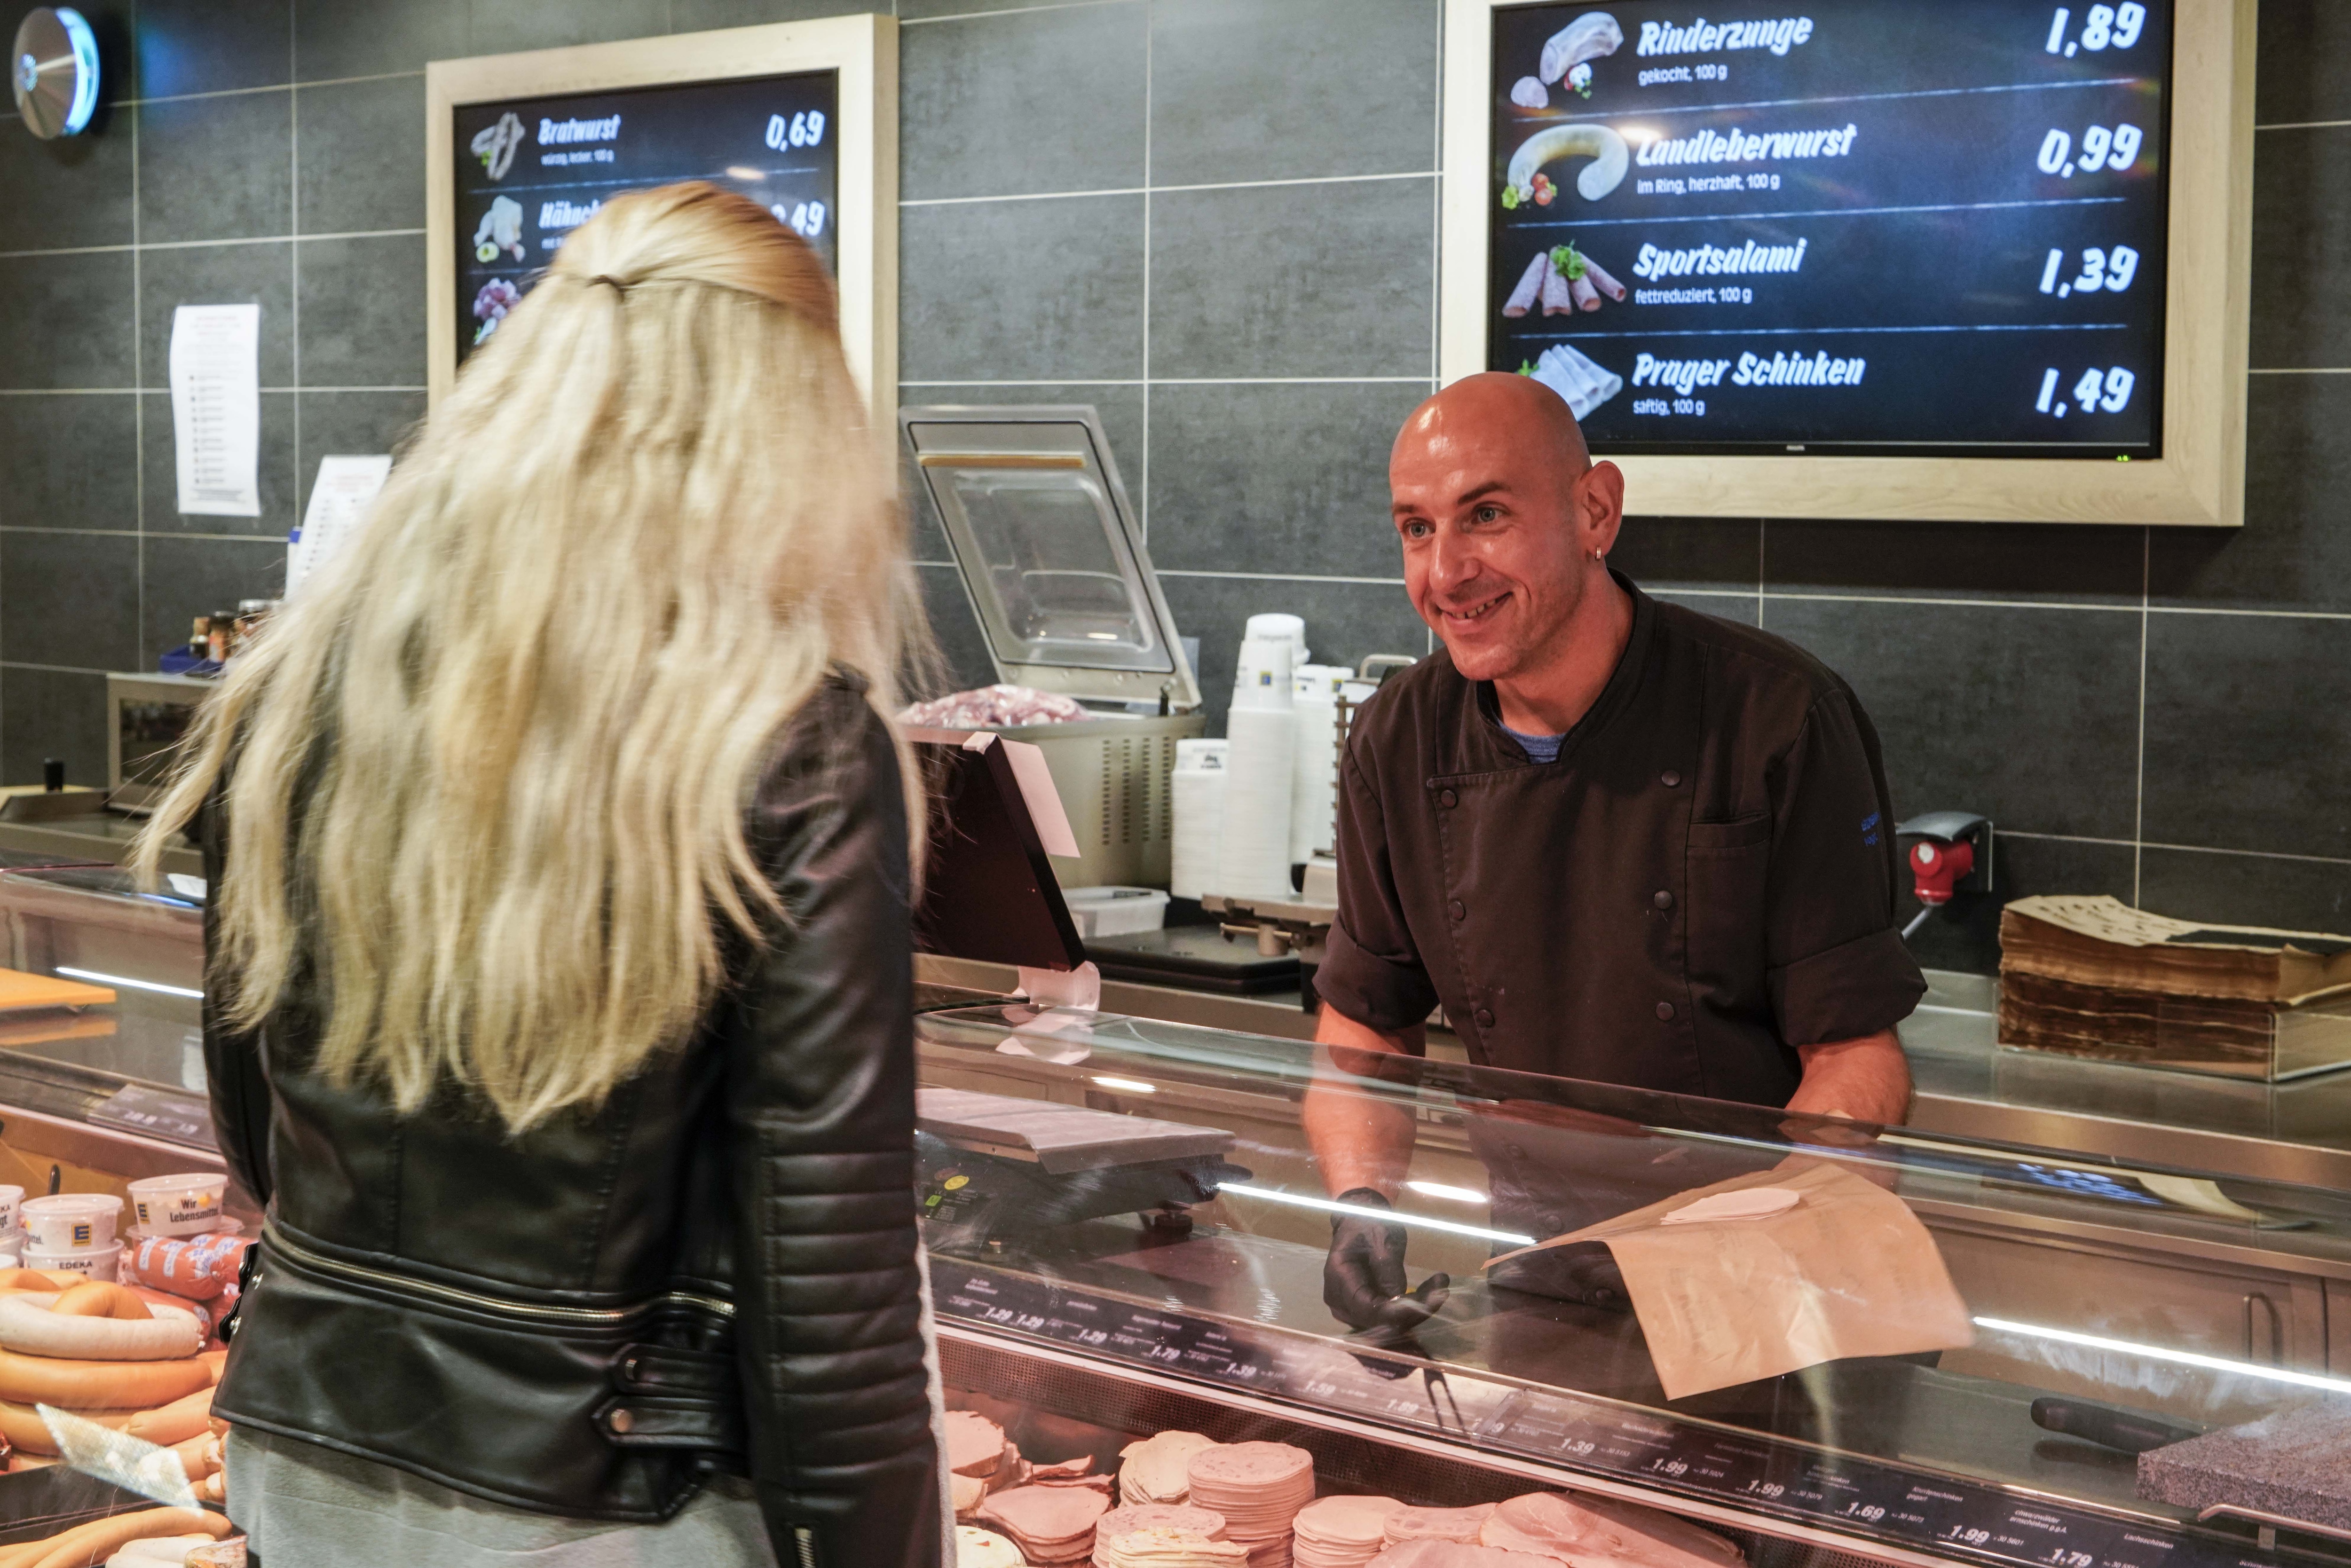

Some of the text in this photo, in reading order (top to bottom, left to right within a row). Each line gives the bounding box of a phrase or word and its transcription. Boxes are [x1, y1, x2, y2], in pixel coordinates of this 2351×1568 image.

[1636, 17, 1813, 56] Rinderzunge
[2045, 1, 2146, 58] 1,89
[1638, 65, 1728, 86] gekocht, 100 g
[538, 114, 621, 145] Bratwurst
[766, 110, 825, 152] 0,69
[1636, 123, 1857, 166] Landleberwurst
[2037, 123, 2143, 178] 0,99
[1637, 173, 1780, 195] im Ring, herzhaft, 100 g
[1633, 237, 1808, 282] Sportsalami
[2039, 245, 2139, 299] 1,39
[1635, 287, 1752, 304] fettreduziert, 100 g
[1632, 350, 1866, 396] Prager Schinken
[2035, 366, 2135, 418] 1,49
[1633, 399, 1705, 417] saftig, 100 g
[181, 1198, 197, 1210] Wir
[75, 1225, 89, 1240] E
[59, 1261, 92, 1269] EDEKA
[1560, 1438, 1595, 1453] 1.39
[1652, 1458, 1689, 1474] 1.99
[1749, 1480, 1785, 1497] 1.99
[1847, 1502, 1886, 1520] 1.69
[1951, 1525, 1990, 1543] 1.99
[2051, 1548, 2093, 1567] 1.79
